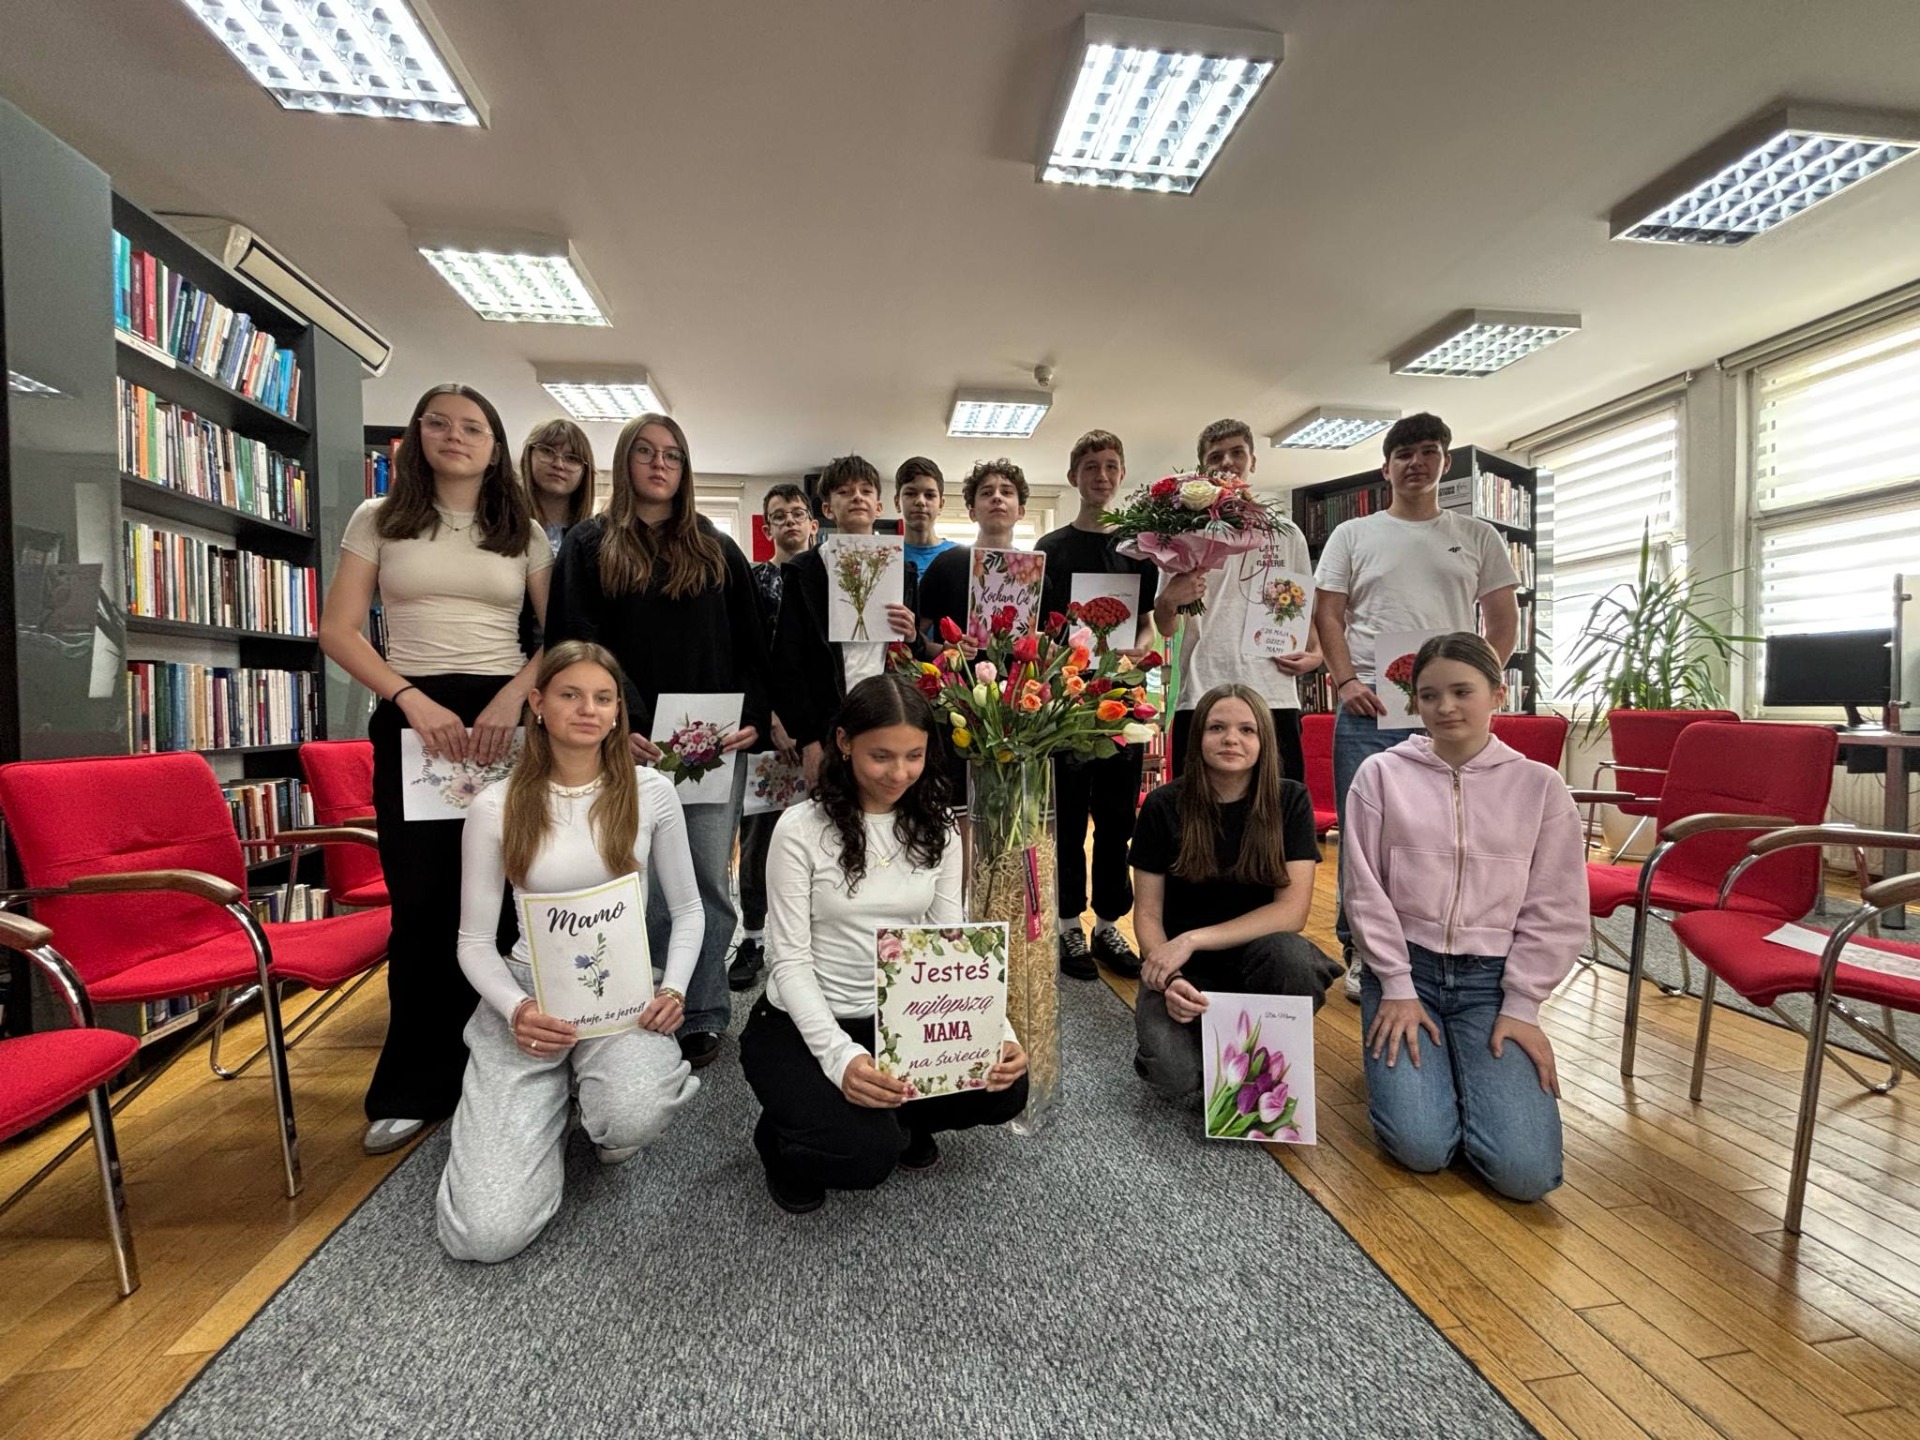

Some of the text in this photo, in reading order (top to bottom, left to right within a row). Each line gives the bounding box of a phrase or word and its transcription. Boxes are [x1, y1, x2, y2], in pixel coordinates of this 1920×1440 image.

[981, 583, 1015, 603] Kocham
[547, 901, 626, 937] Mamo
[911, 956, 990, 984] Jesteś
[605, 1010, 615, 1020] że
[902, 993, 994, 1021] najlepszą
[923, 1020, 972, 1043] MAMĄ
[908, 1048, 991, 1069] na świecie
